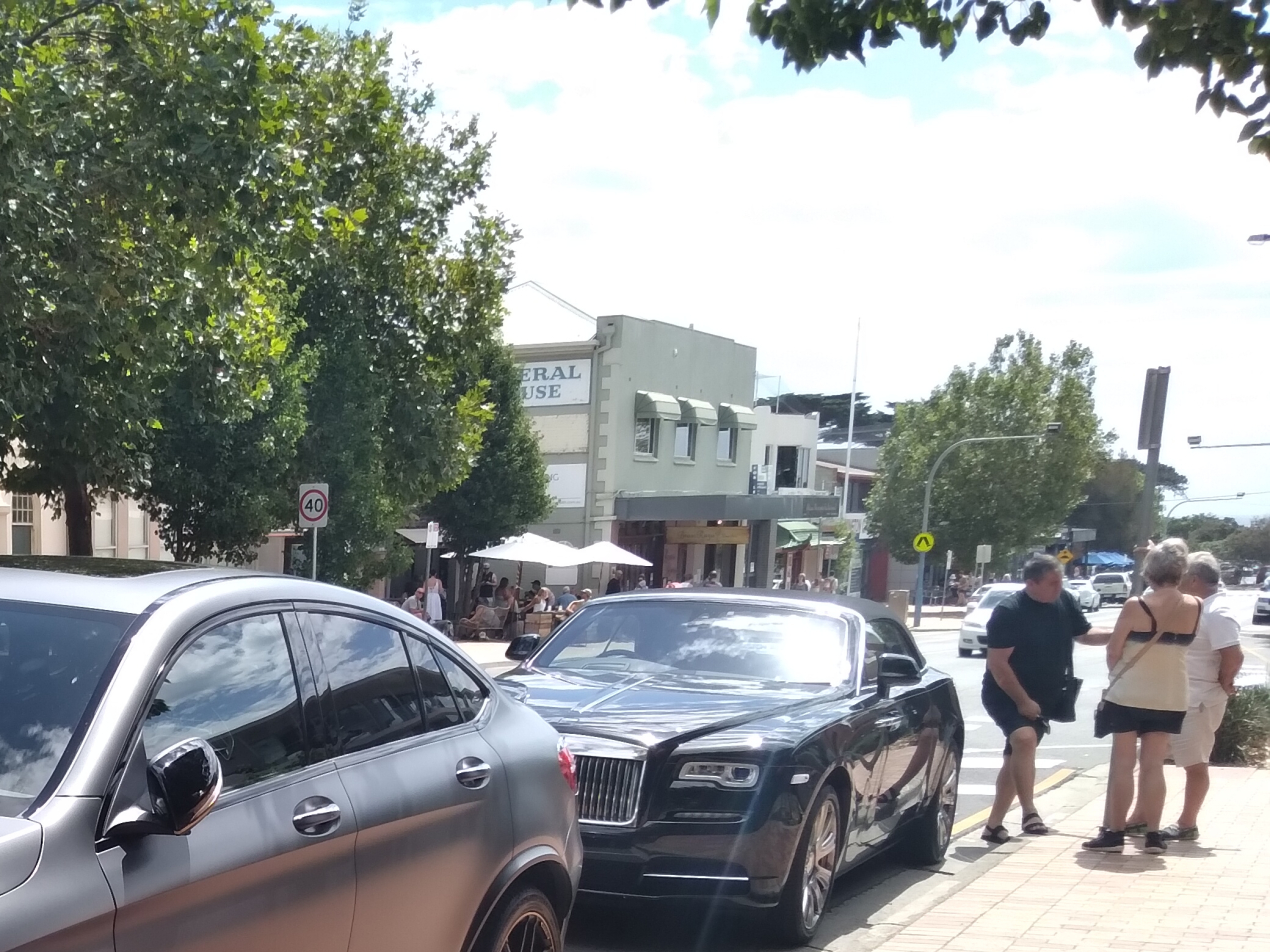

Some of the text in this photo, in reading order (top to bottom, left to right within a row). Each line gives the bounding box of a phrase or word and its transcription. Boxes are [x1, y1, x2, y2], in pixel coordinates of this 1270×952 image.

[521, 366, 581, 381] ERAL
[523, 385, 561, 399] USE
[305, 499, 323, 512] 40
